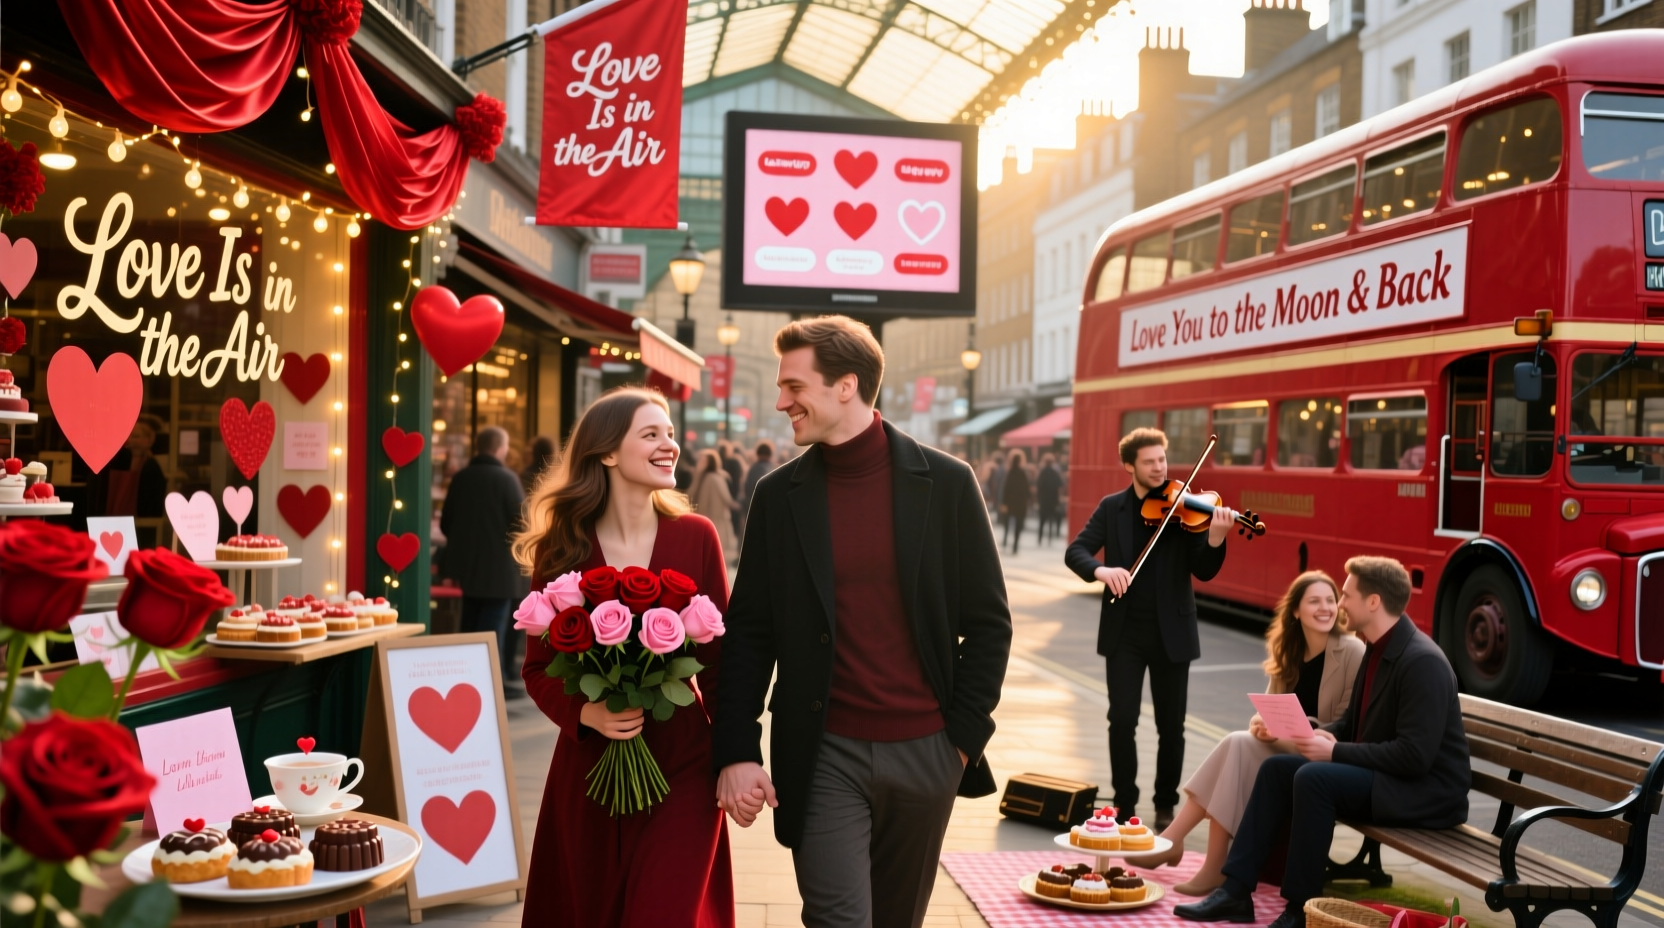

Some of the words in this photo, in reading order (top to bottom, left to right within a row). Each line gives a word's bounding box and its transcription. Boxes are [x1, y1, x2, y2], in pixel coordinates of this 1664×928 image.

[566, 42, 662, 99] Love
[586, 98, 616, 130] Is
[623, 92, 655, 123] in
[553, 132, 597, 167] the
[588, 126, 666, 177] Air
[57, 192, 205, 334] Love
[209, 226, 254, 305] Is
[264, 261, 297, 314] in
[1129, 319, 1167, 353] Love
[1171, 308, 1204, 347] You
[1209, 305, 1229, 339] to
[1234, 292, 1267, 335] the
[1271, 283, 1340, 328] Moon
[1346, 268, 1370, 314] &
[1376, 249, 1453, 310] Back
[140, 311, 202, 377] the
[200, 311, 285, 388] Air
